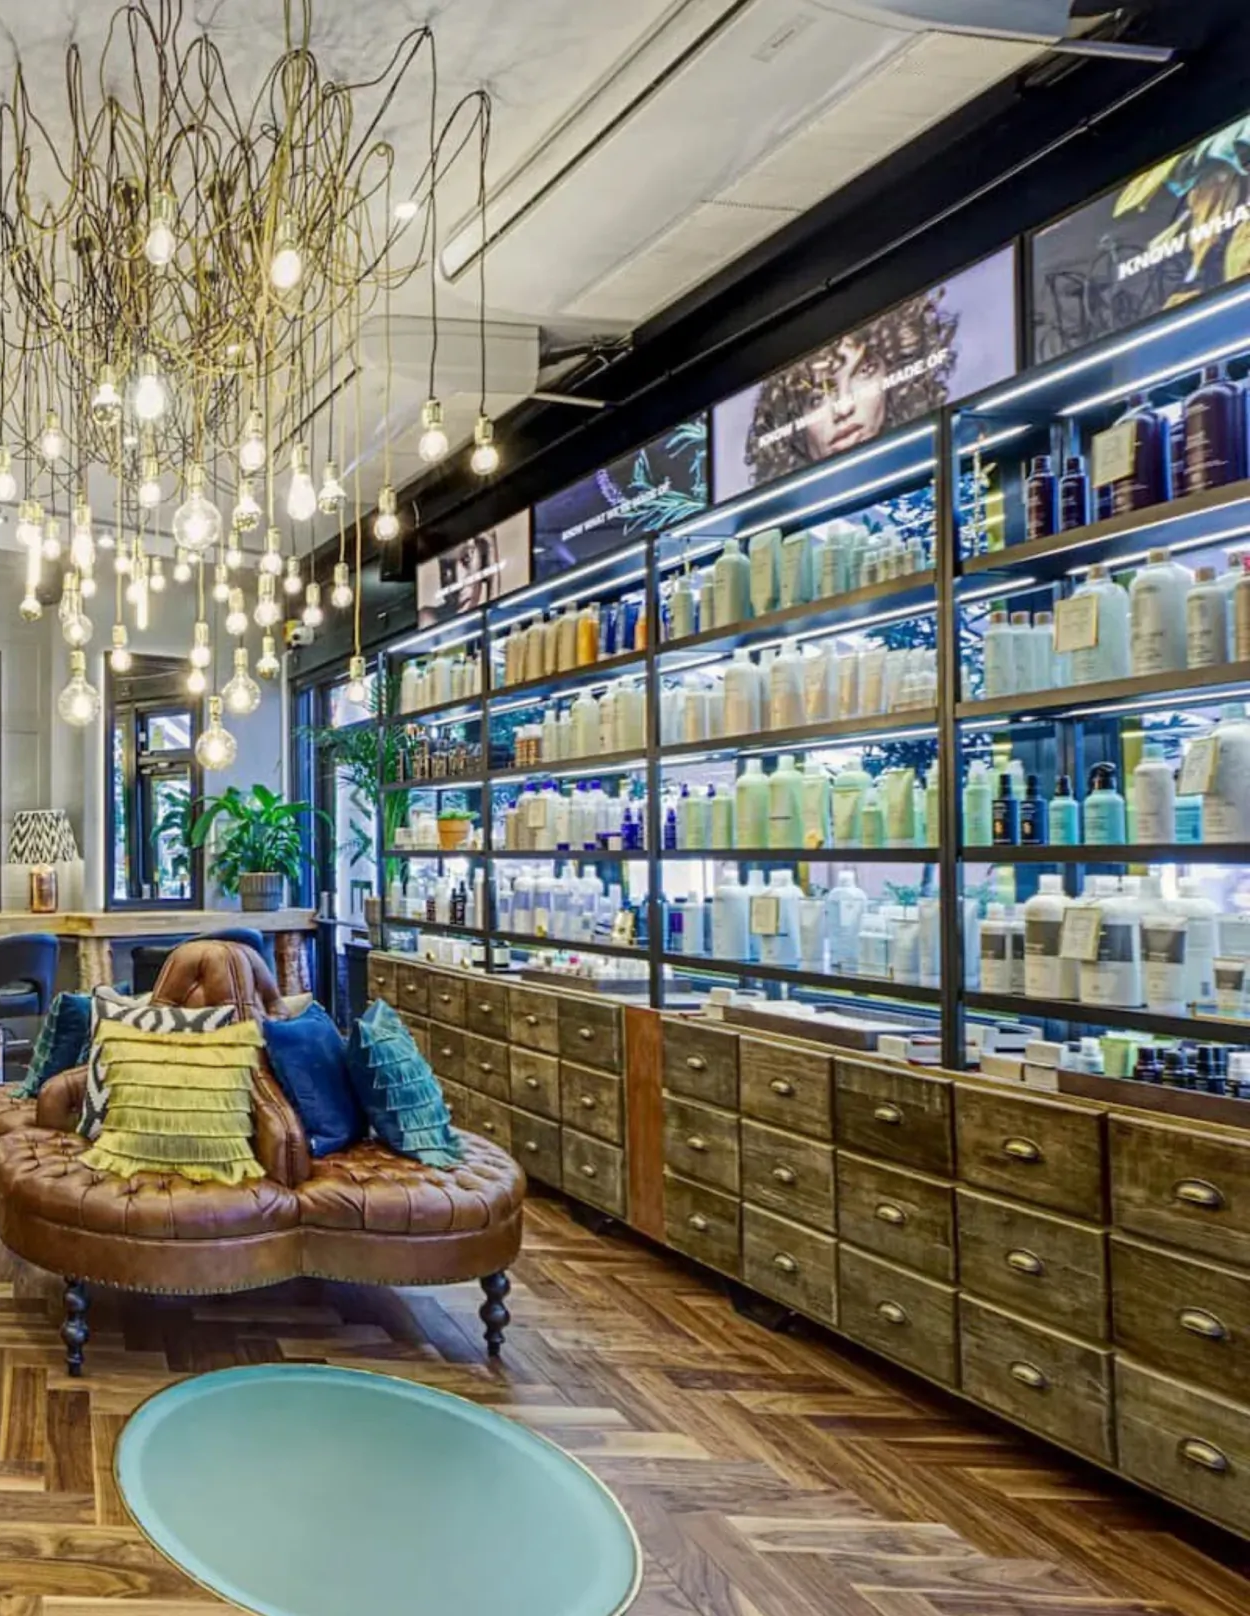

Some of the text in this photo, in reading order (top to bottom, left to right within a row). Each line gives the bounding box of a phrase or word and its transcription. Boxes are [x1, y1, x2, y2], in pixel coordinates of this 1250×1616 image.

[1117, 196, 1250, 281] KNOW WHA
[881, 359, 928, 391] MADE
[926, 347, 949, 369] OF
